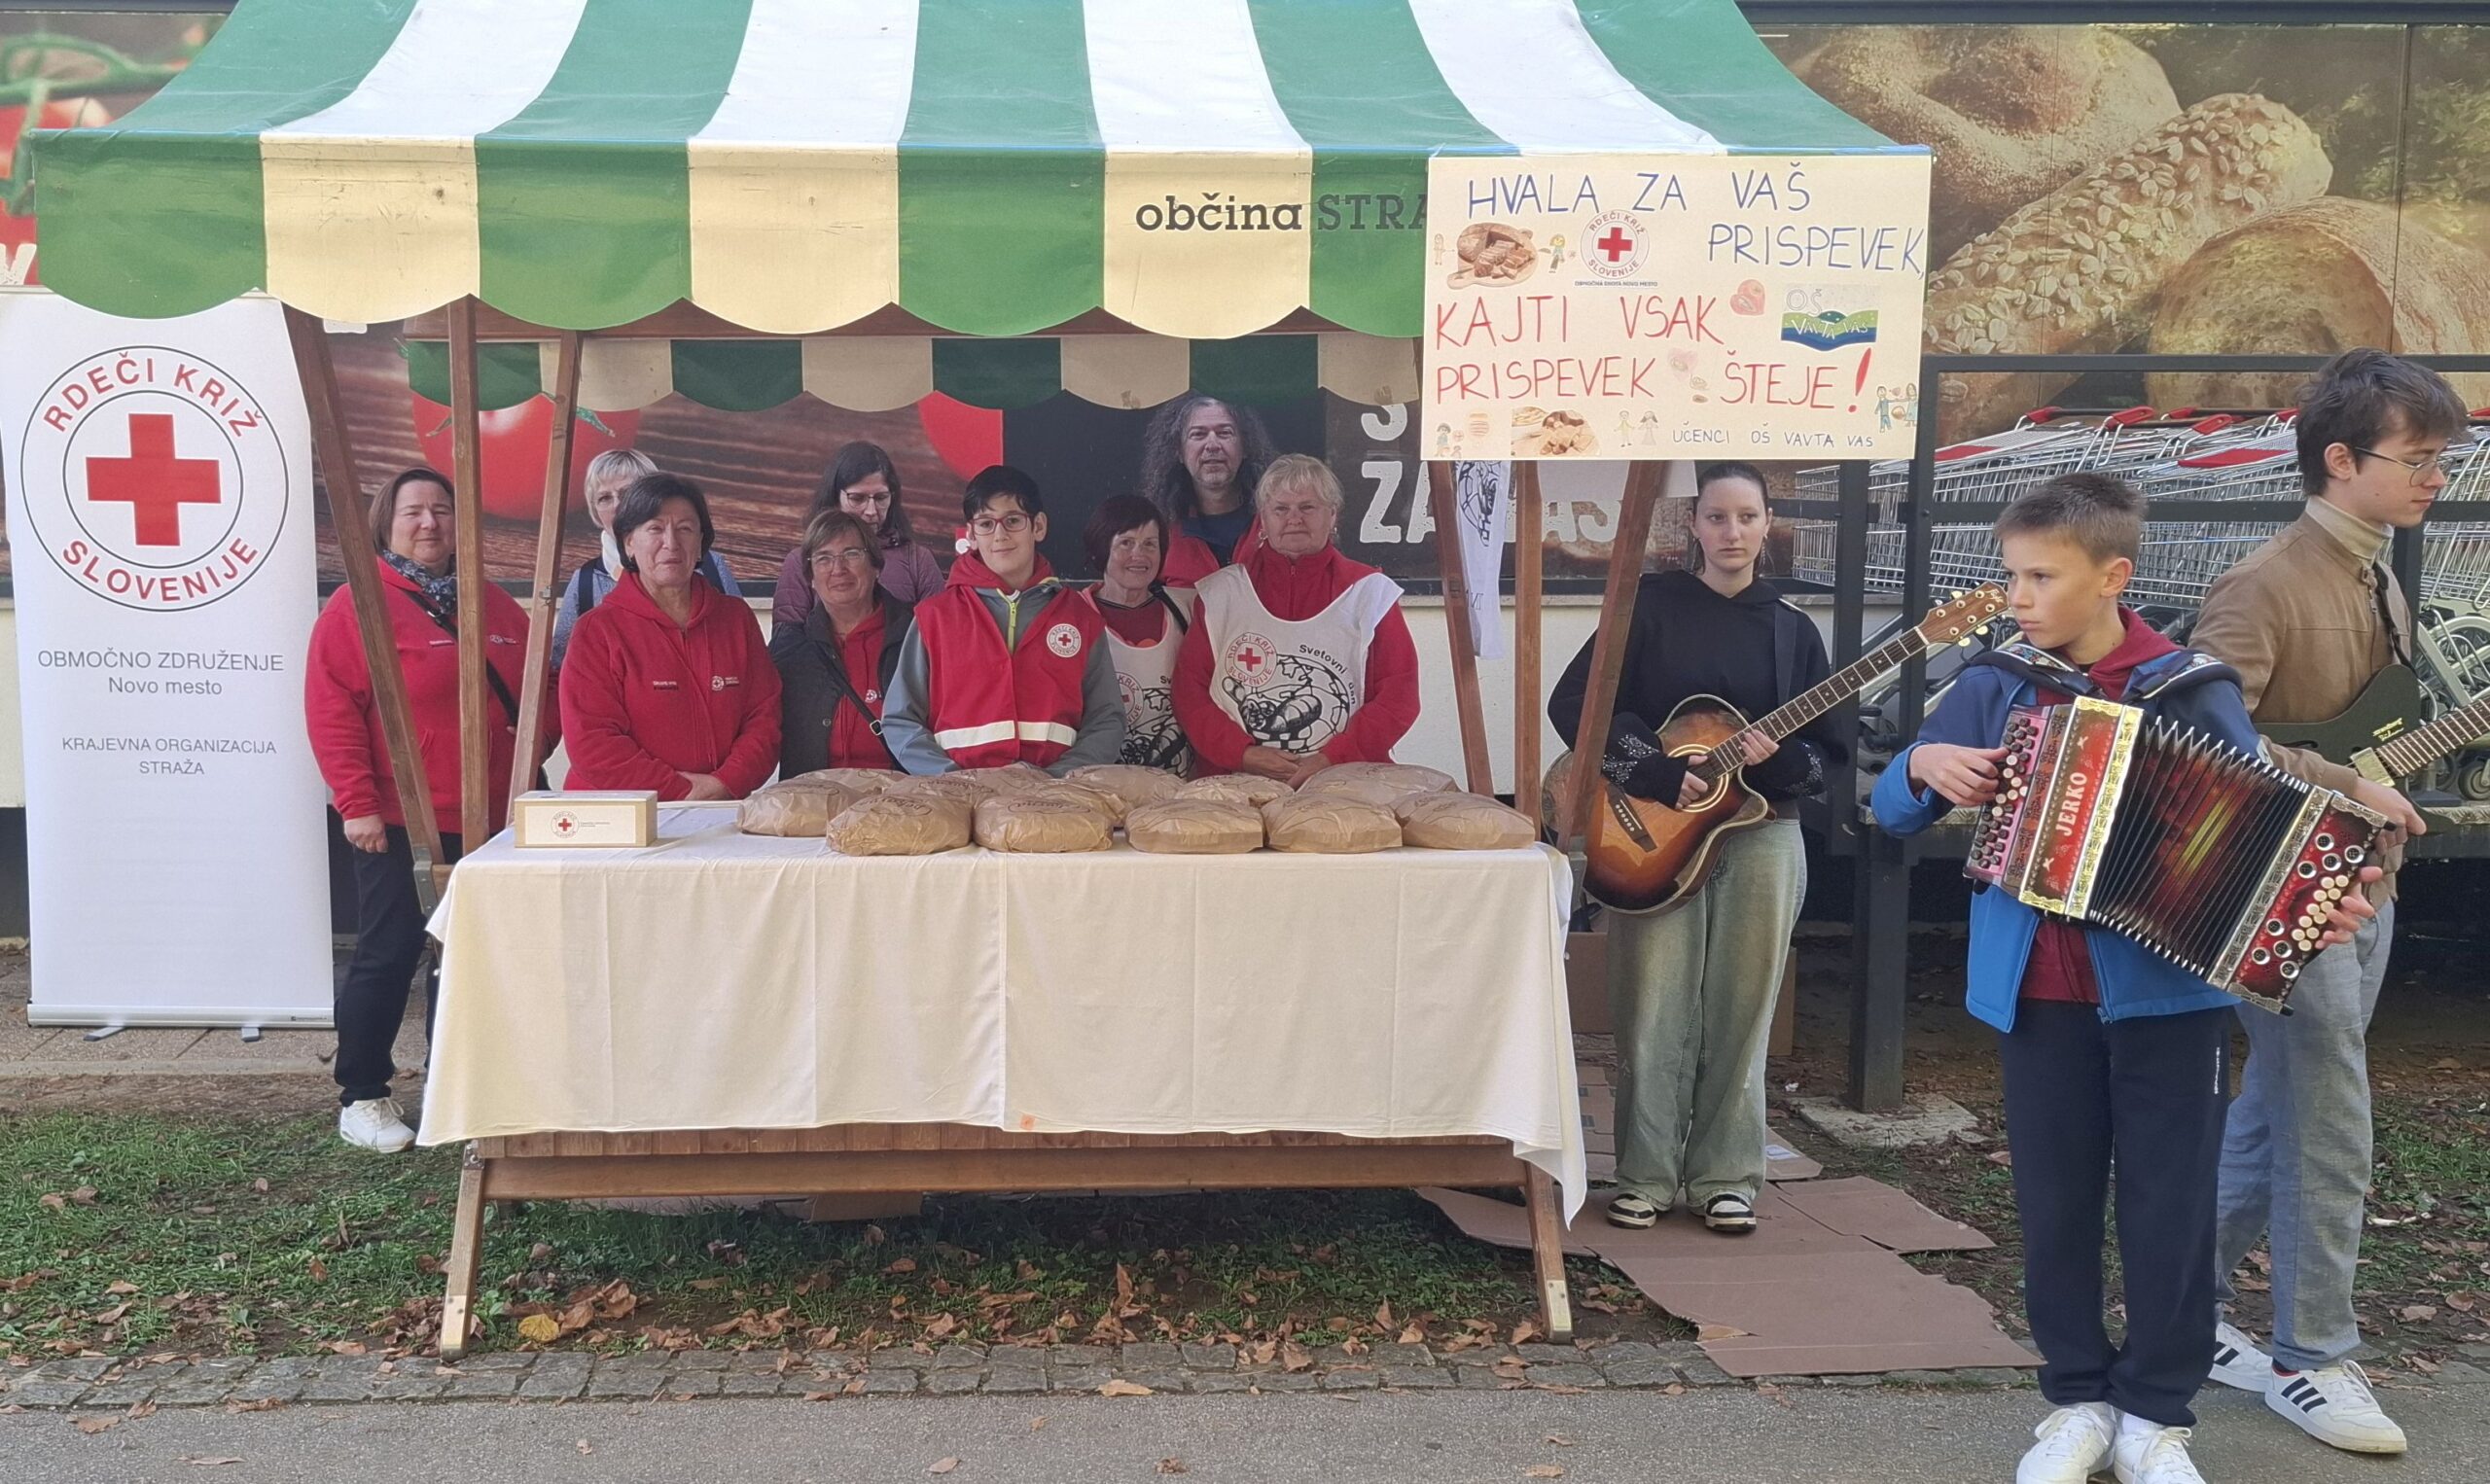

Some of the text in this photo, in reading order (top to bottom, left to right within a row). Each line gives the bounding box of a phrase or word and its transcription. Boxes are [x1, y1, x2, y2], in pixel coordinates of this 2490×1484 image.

[1468, 161, 1811, 219] HVALA ZA VAŠ
[1136, 193, 1302, 231] občina
[1588, 211, 1620, 231] RDEČI
[1588, 259, 1640, 277] SLOVENIJE
[1437, 295, 1725, 350] KAJTI VSAK
[44, 351, 264, 437] RDEČI KRIŽ
[1437, 356, 1657, 405] PRISPEVEK
[1672, 420, 1873, 447] UČENCI OŠ VAVTA VAS
[62, 538, 259, 602] SLOVENIJE
[38, 647, 285, 671] OBMOČNO ZDRUŽENJE
[1299, 644, 1348, 674] Svetovni
[109, 677, 223, 695] Novo mesto
[62, 738, 277, 754] KRAJEVNA ORGANIZACIJA
[139, 758, 204, 775] STRAŽA
[2055, 771, 2087, 836] JERKO
